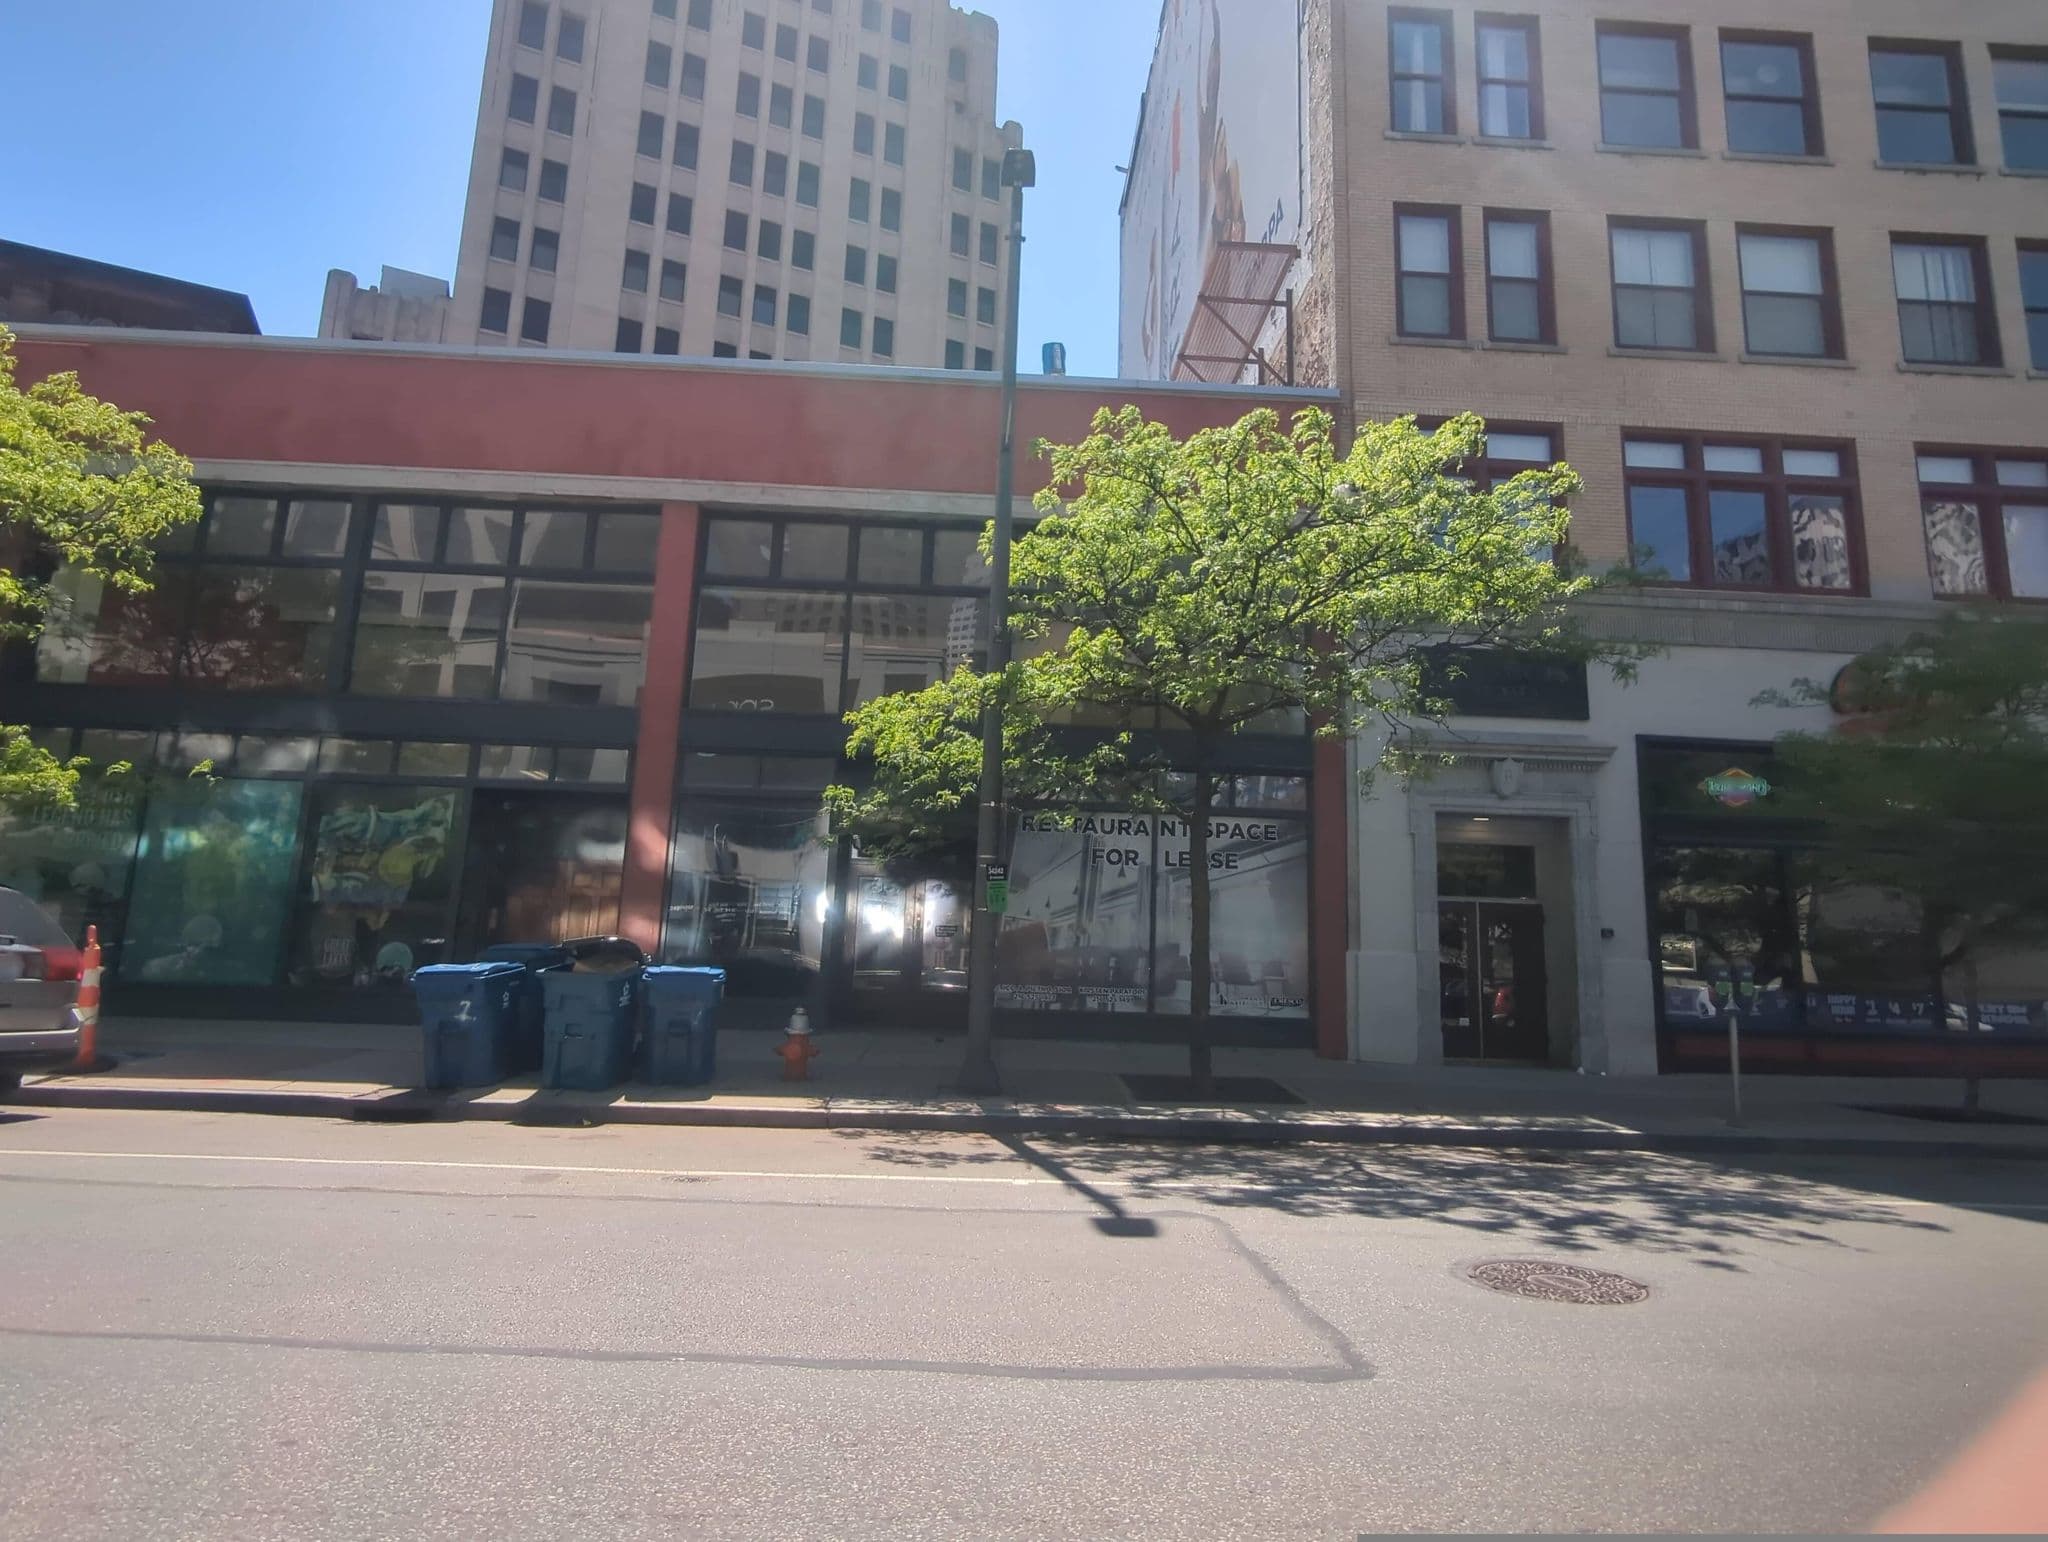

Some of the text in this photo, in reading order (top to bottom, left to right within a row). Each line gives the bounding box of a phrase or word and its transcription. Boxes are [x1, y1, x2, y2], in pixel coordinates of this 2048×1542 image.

[1022, 815, 1190, 839] RETAURANT
[1091, 848, 1238, 871] FOR LESE
